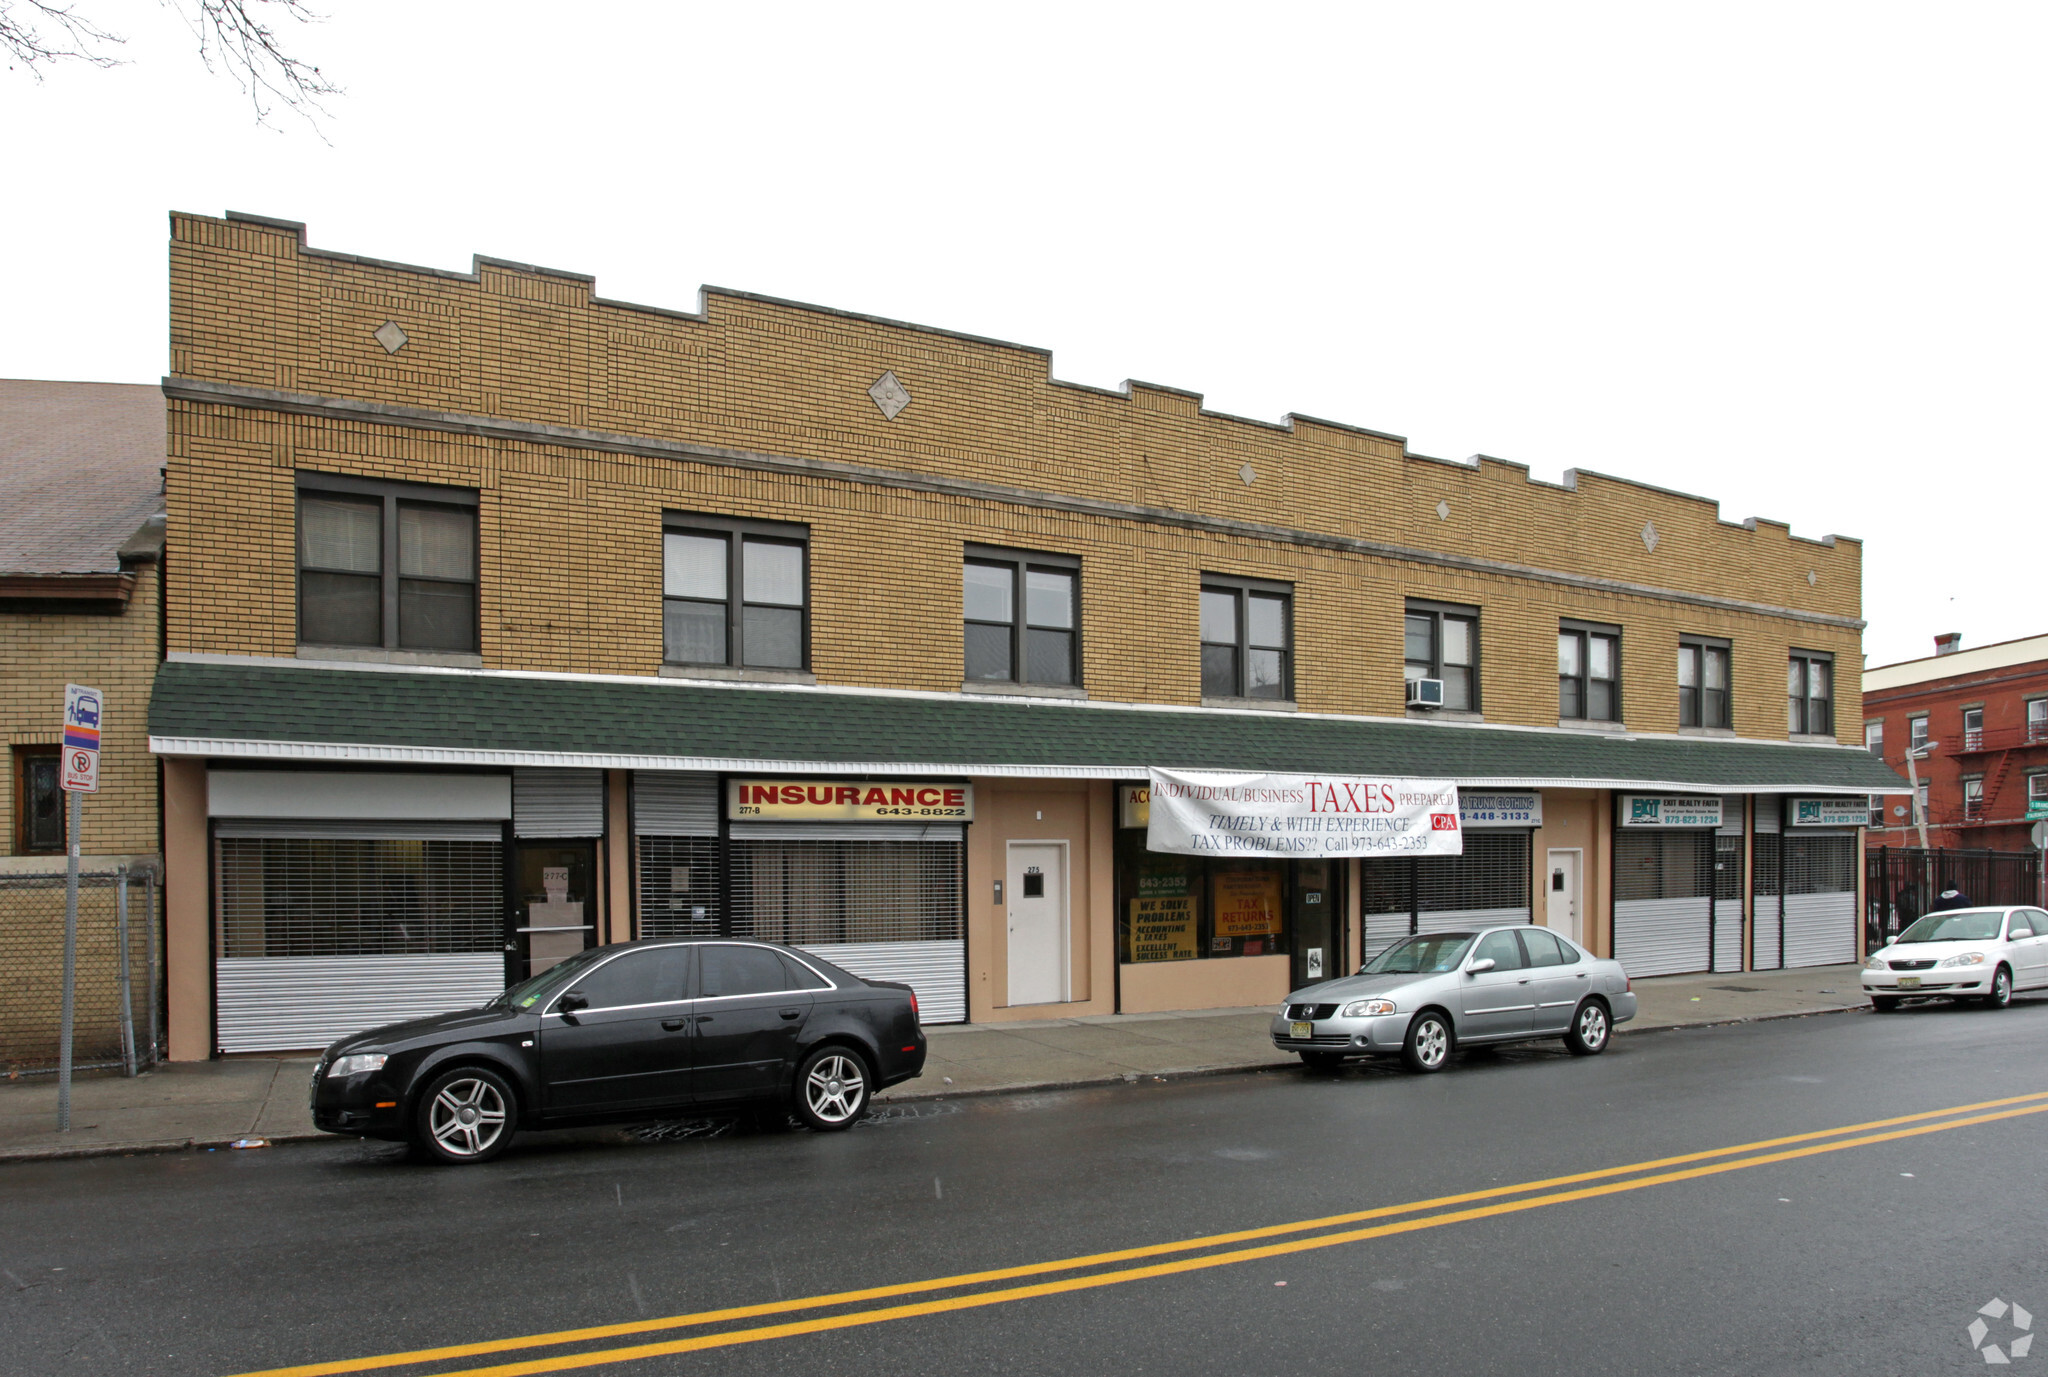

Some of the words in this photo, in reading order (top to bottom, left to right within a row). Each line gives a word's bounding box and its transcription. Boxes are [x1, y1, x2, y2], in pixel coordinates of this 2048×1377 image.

[77, 688, 98, 697] TRANSIT
[67, 771, 78, 780] BUS
[80, 773, 93, 781] STOP
[738, 785, 965, 807] INSURANCE
[1154, 781, 1304, 803] INDIVIDUAL/BUSINESS
[1305, 782, 1395, 813] TAXES
[1400, 792, 1454, 806] PREPARED
[1469, 796, 1495, 810] TRUNK
[1496, 797, 1534, 810] CLOTHING
[1663, 799, 1677, 807] EXIT
[1678, 799, 1701, 807] REALTY
[1702, 799, 1719, 807] FAITH
[876, 807, 966, 816] 643-8822
[1208, 814, 1268, 831] TIMELY
[1270, 816, 1282, 831] &
[1287, 817, 1322, 831] WITH
[1327, 817, 1410, 832] EXPERIENCE
[1433, 816, 1454, 831] CPA
[1664, 815, 1718, 824] 973-623-1234
[1191, 834, 1221, 849] TAX
[1225, 835, 1318, 852] PROBLEMS??
[1325, 836, 1348, 851] Call
[1352, 836, 1428, 851] 973-643-2353
[1027, 866, 1040, 874] 275
[544, 872, 568, 881] 277-C
[1140, 877, 1187, 888] 643-2353
[1140, 901, 1156, 911] WE
[1160, 900, 1189, 910] SOLVE
[1237, 898, 1259, 910] TAX
[1137, 911, 1191, 923] PROBLEMS
[1222, 910, 1274, 923] RETURNS
[1137, 924, 1186, 934] ACCOUNTING
[1144, 933, 1168, 942] TAXES
[1136, 943, 1178, 952] EXCELLENT
[1136, 951, 1168, 960] SUCCESS
[1173, 950, 1192, 959] RATE
